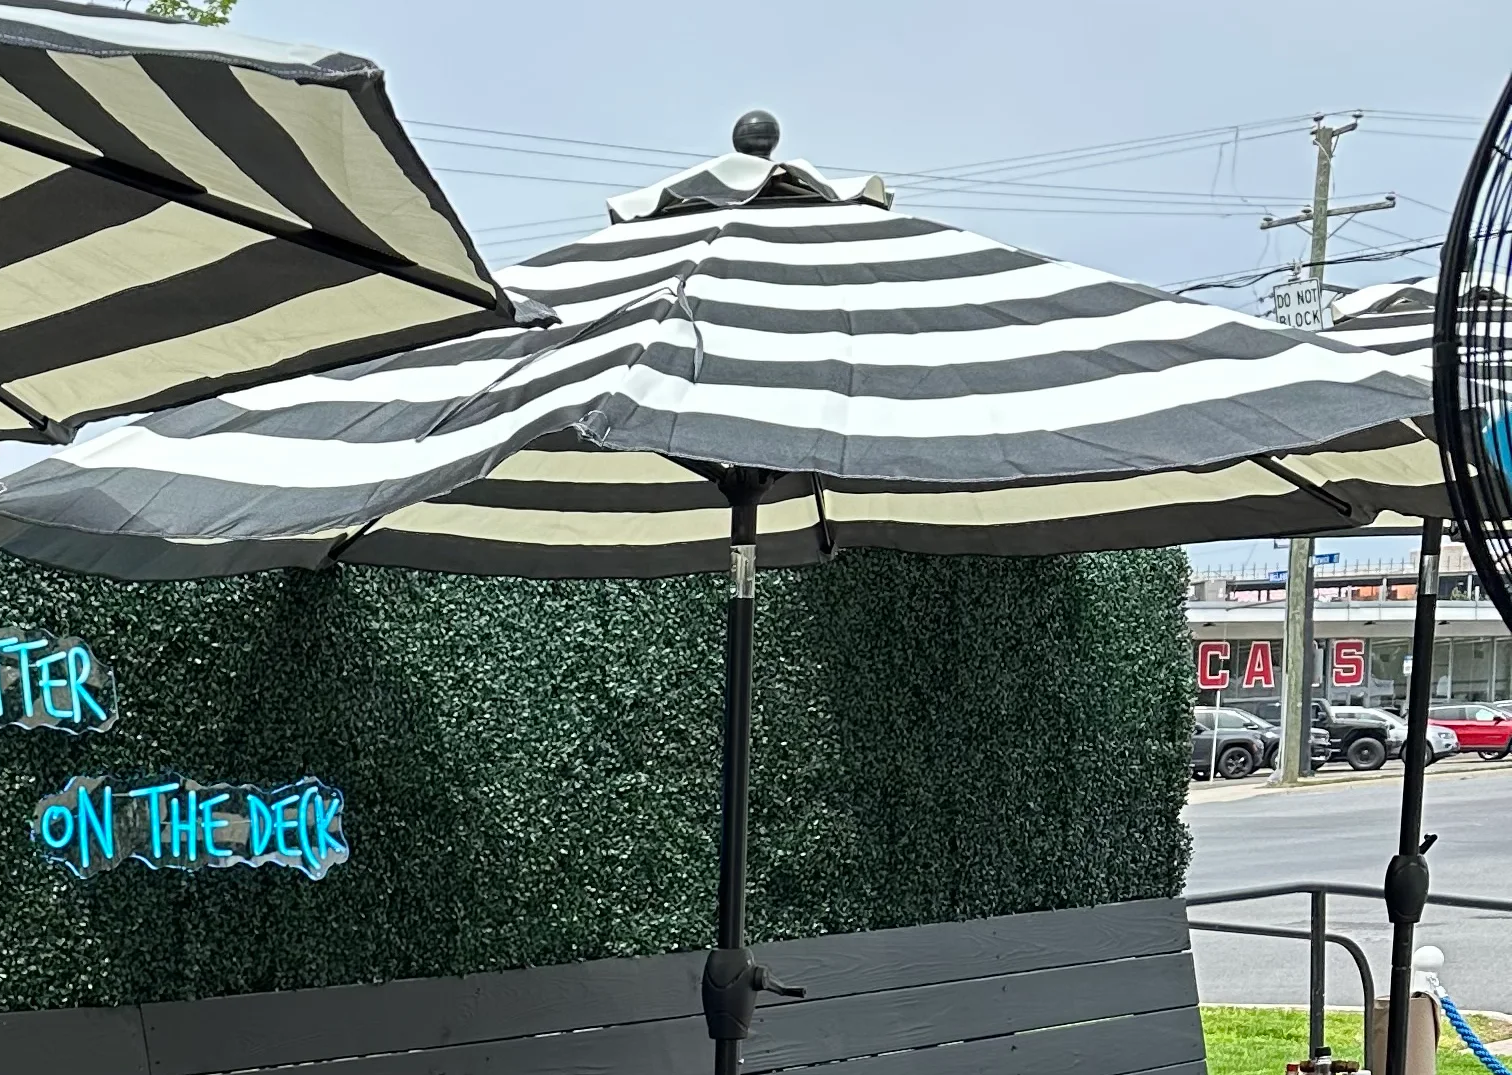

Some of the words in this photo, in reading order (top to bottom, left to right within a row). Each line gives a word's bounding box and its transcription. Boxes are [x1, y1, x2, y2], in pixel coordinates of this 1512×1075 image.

[1277, 293, 1291, 309] DO
[1297, 288, 1317, 306] NOT
[1198, 640, 1365, 690] CAS
[41, 786, 113, 867] ON
[129, 783, 231, 862] THE
[246, 786, 343, 869] DECK
